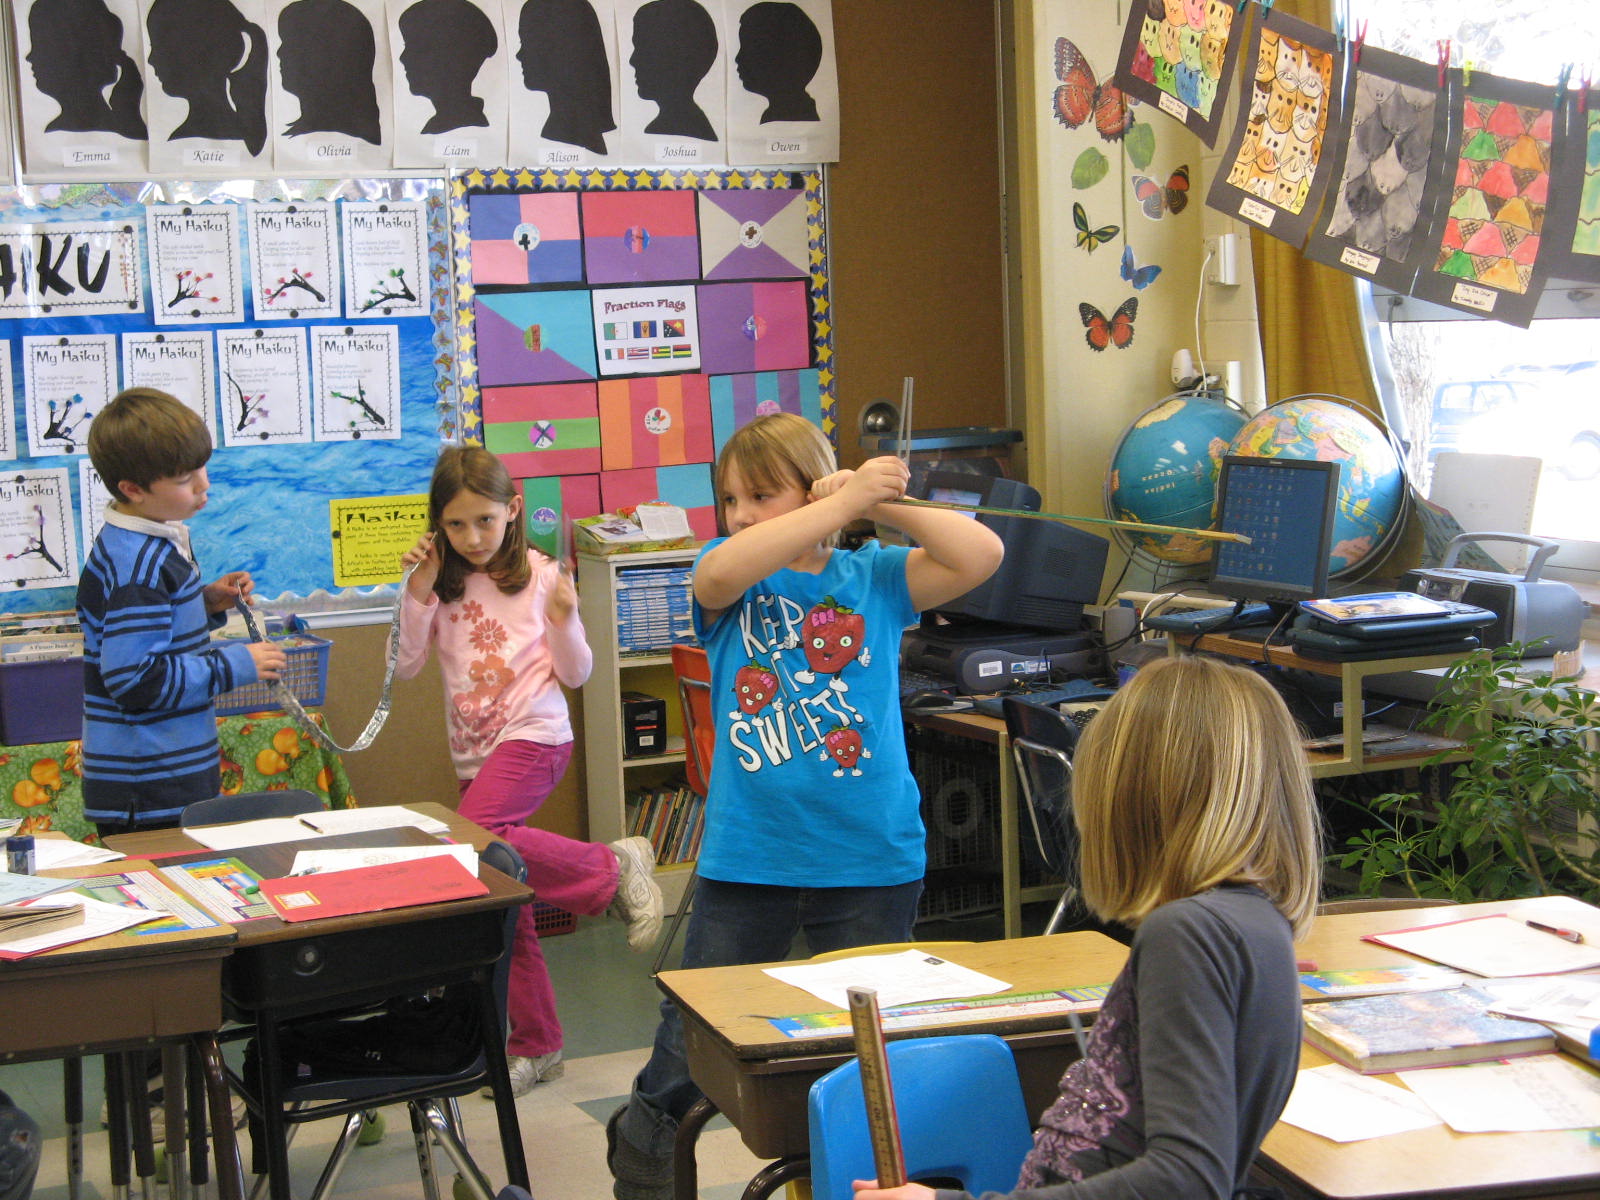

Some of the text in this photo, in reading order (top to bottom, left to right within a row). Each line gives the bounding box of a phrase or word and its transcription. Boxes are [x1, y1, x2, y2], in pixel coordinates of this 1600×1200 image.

[317, 145, 352, 157] Olivia
[443, 145, 470, 156] Liam
[662, 146, 697, 159] Joshua
[771, 141, 800, 152] Owen
[73, 151, 112, 161] Emma
[193, 150, 225, 162] Katie
[548, 151, 579, 162] Alison
[160, 217, 223, 235] My Haiku
[261, 214, 321, 232] My Haiku
[354, 214, 411, 232] My Haiku
[604, 299, 686, 314] Fraction Flags
[232, 341, 292, 358] My Haiku
[325, 339, 383, 354] My Haiku
[37, 349, 100, 366] My Haiku
[136, 346, 197, 362] My Haiku
[16, 484, 54, 498] Haiku
[346, 511, 425, 523] Haiku
